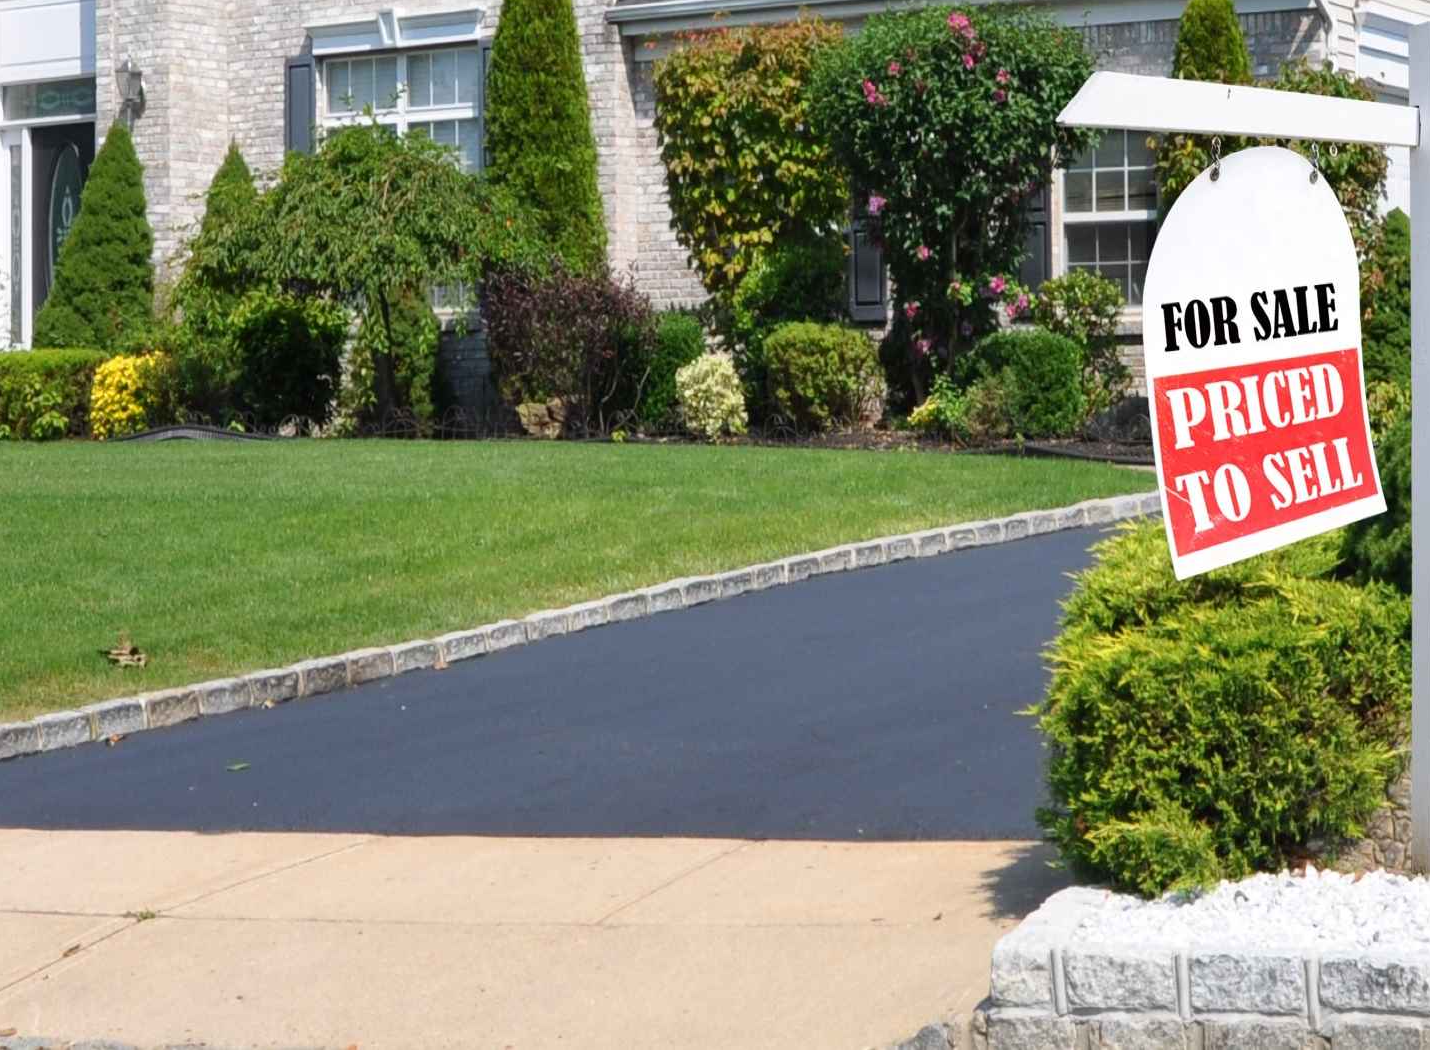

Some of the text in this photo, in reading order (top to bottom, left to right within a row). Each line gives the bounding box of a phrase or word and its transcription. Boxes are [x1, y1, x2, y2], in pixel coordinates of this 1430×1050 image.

[1161, 282, 1339, 352] FOR SALE
[1164, 363, 1344, 450] PRICED
[1174, 437, 1363, 534] TO SELL
